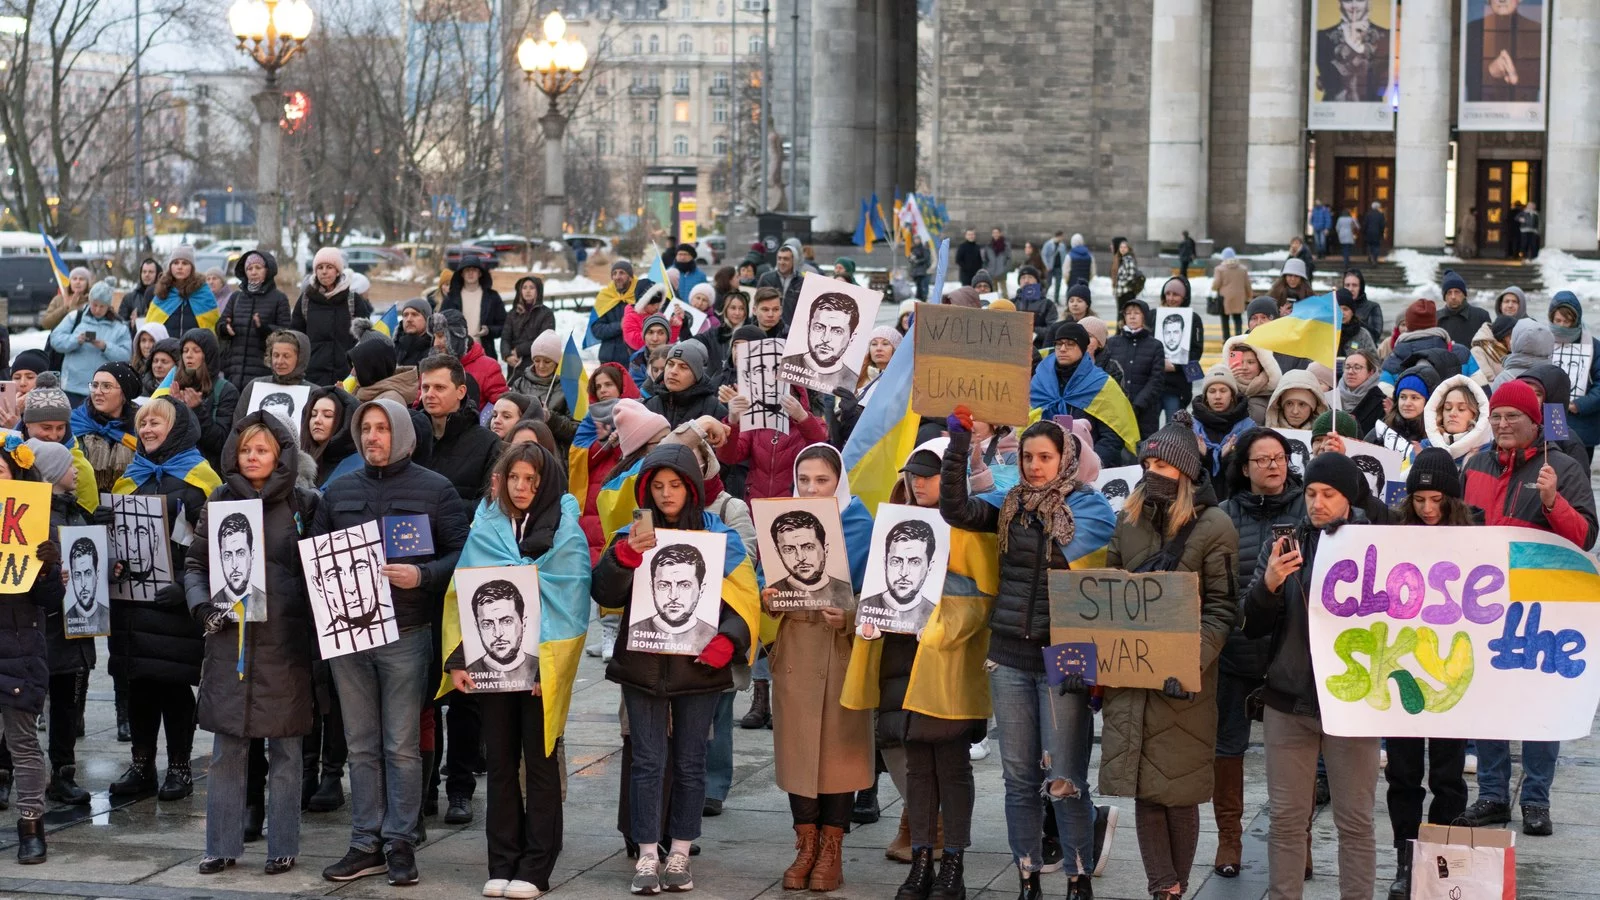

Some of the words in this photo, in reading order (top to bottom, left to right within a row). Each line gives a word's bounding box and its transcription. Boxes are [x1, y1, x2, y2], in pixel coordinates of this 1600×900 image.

[925, 316, 1012, 347] WOLNA
[783, 363, 819, 379] CHWAŁA
[781, 371, 835, 391] BOHATEROM
[0, 496, 30, 546] K
[0, 551, 30, 587] N
[772, 599, 831, 608] BOHATEROM
[861, 605, 901, 618] CHWAŁA
[860, 615, 915, 630] BOHATEROM
[632, 630, 674, 640] CHWAŁA
[631, 640, 692, 651] BOHATEROM
[1091, 636, 1155, 675] WAR
[468, 671, 506, 680] CHWAŁA
[474, 680, 527, 690] OHATEROM
